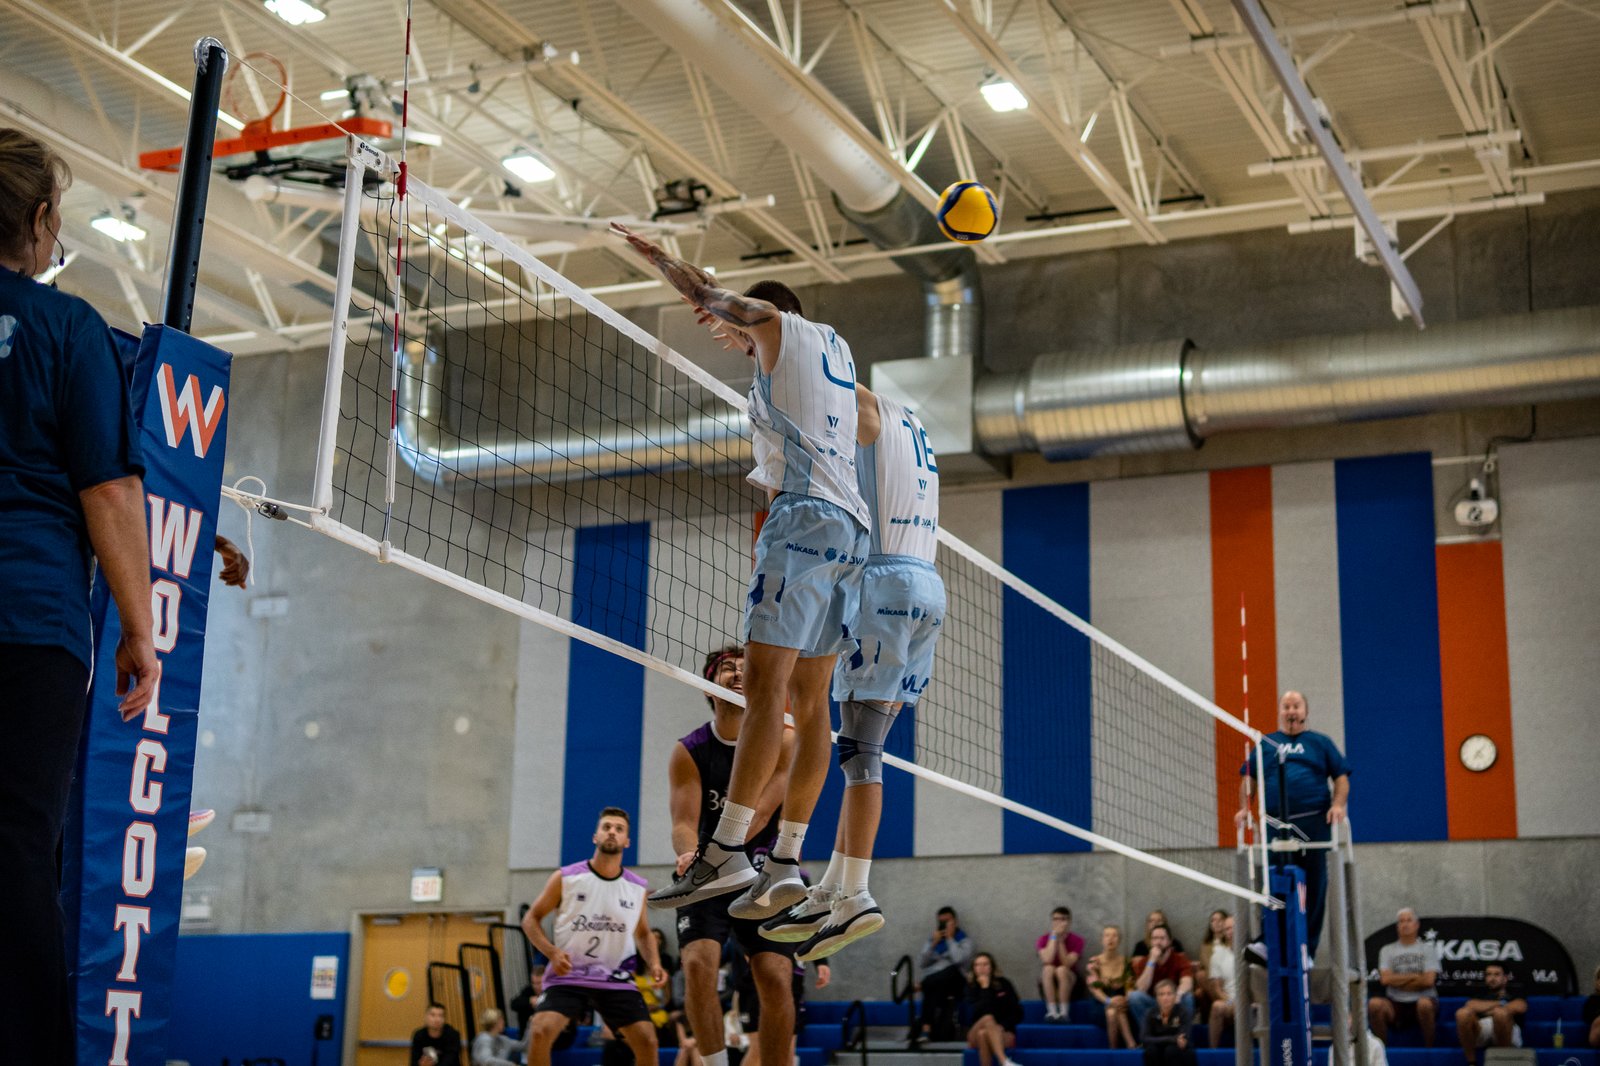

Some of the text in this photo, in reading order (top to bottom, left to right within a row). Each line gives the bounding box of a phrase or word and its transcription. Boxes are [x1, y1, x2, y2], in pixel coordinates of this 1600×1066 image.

[156, 362, 225, 459] W
[584, 936, 600, 958] 2
[1430, 938, 1524, 961] KASA
